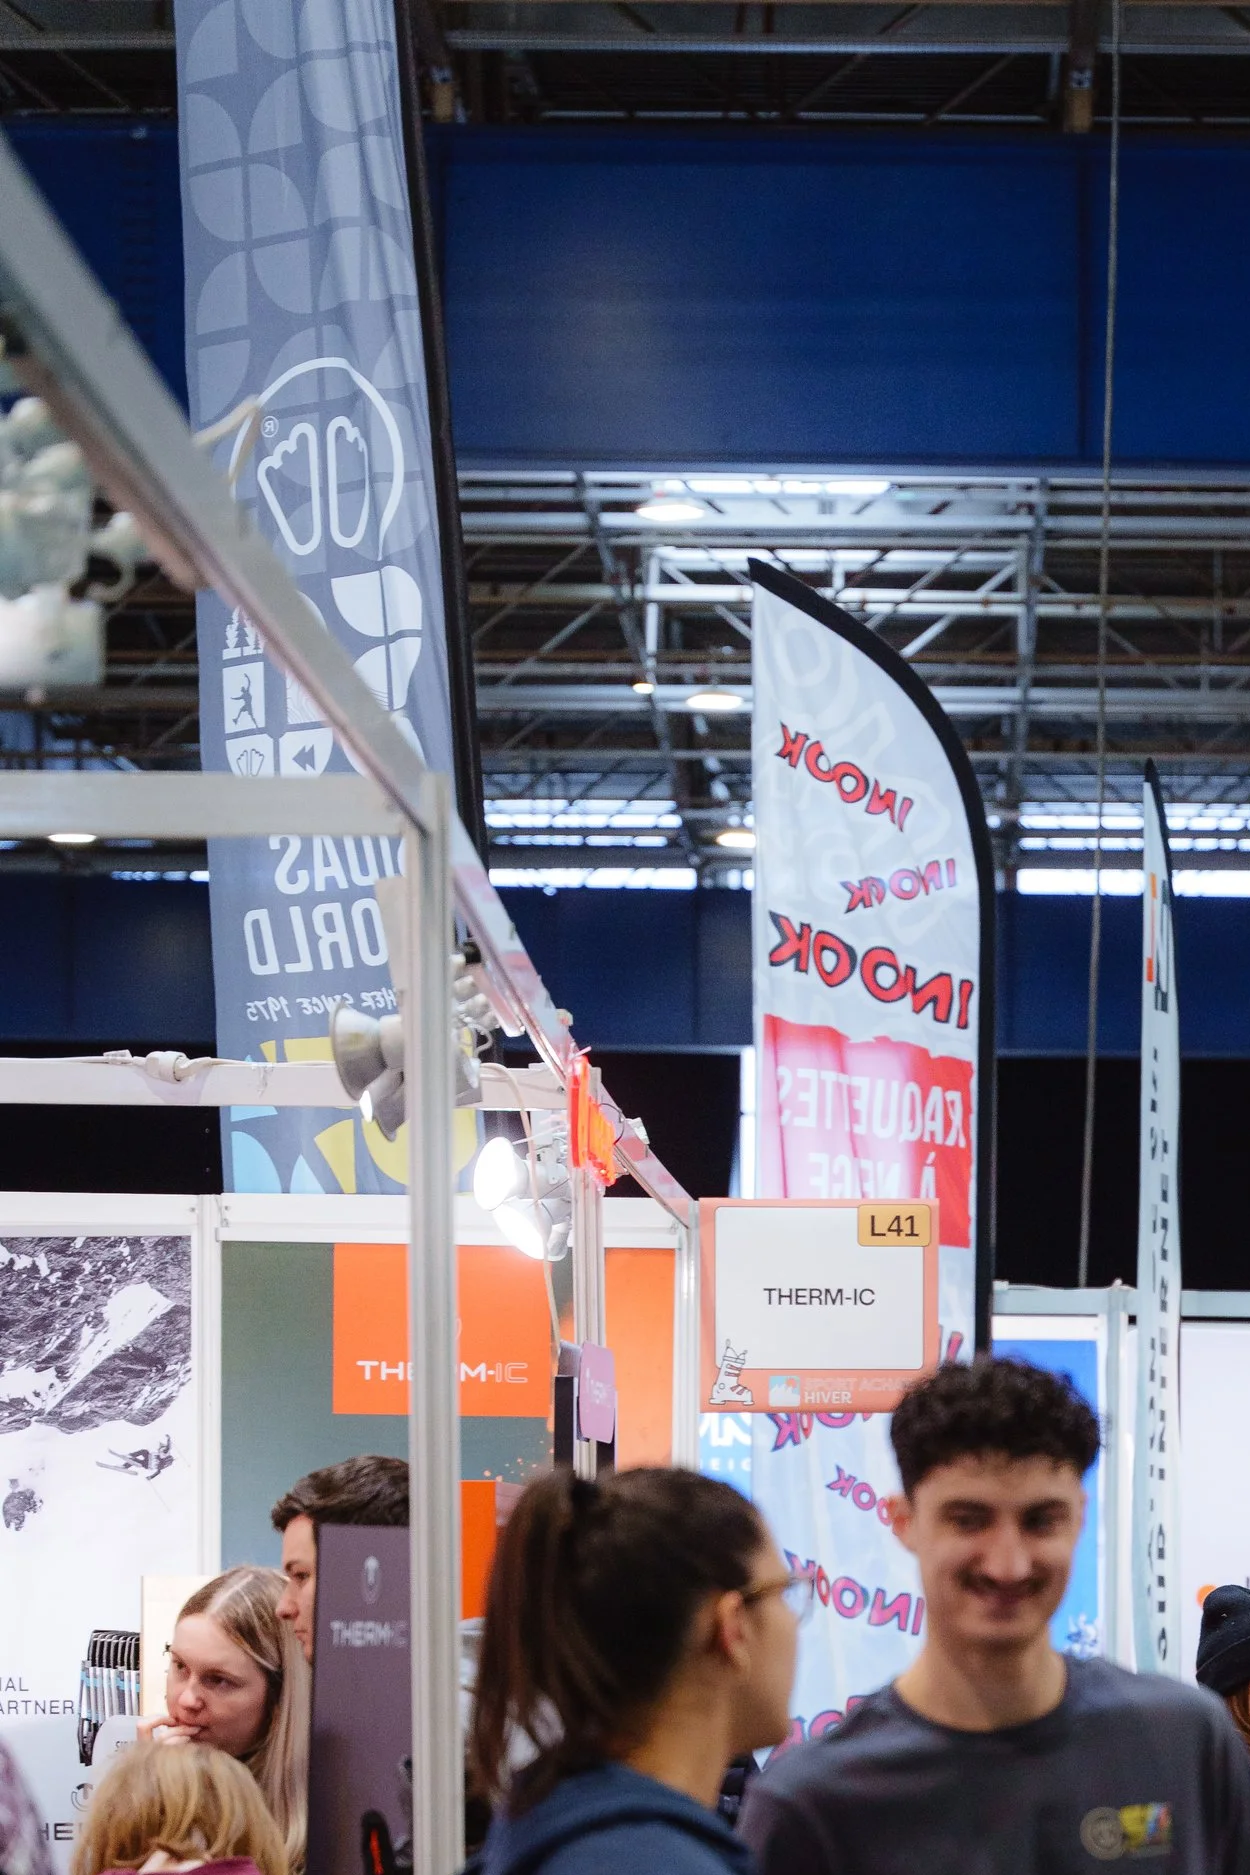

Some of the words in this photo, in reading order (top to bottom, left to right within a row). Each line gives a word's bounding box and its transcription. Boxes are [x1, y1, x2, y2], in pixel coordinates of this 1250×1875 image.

[869, 1214, 920, 1238] L41
[763, 1287, 876, 1306] THERM-IC
[803, 1391, 853, 1405] HIVER
